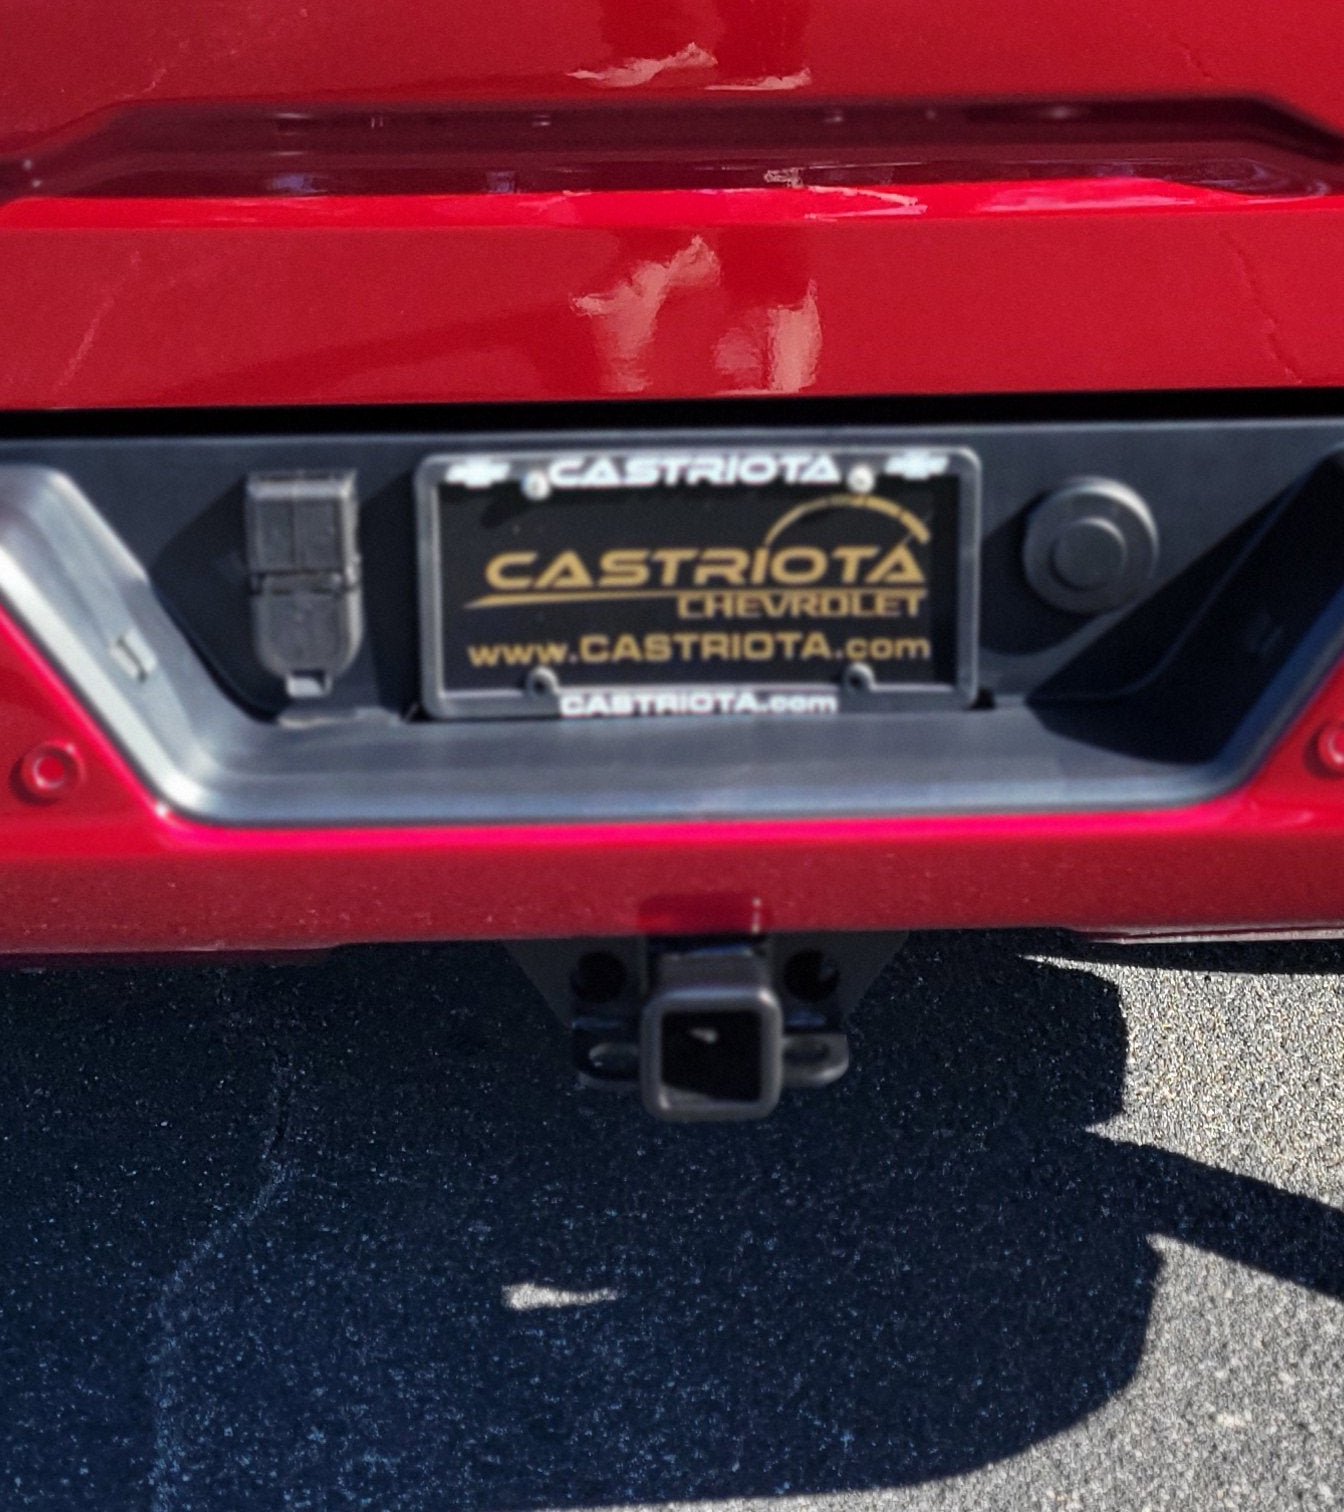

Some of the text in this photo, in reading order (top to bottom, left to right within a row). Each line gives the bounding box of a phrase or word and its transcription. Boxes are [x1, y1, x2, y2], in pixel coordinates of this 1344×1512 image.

[549, 454, 841, 488] CASTRIOTA
[485, 544, 926, 588] CASTRIOTA
[677, 591, 922, 619] CHEVROLET
[467, 632, 931, 667] www.CASTRIOTA.com
[560, 690, 838, 718] CASTRIOTA.com
